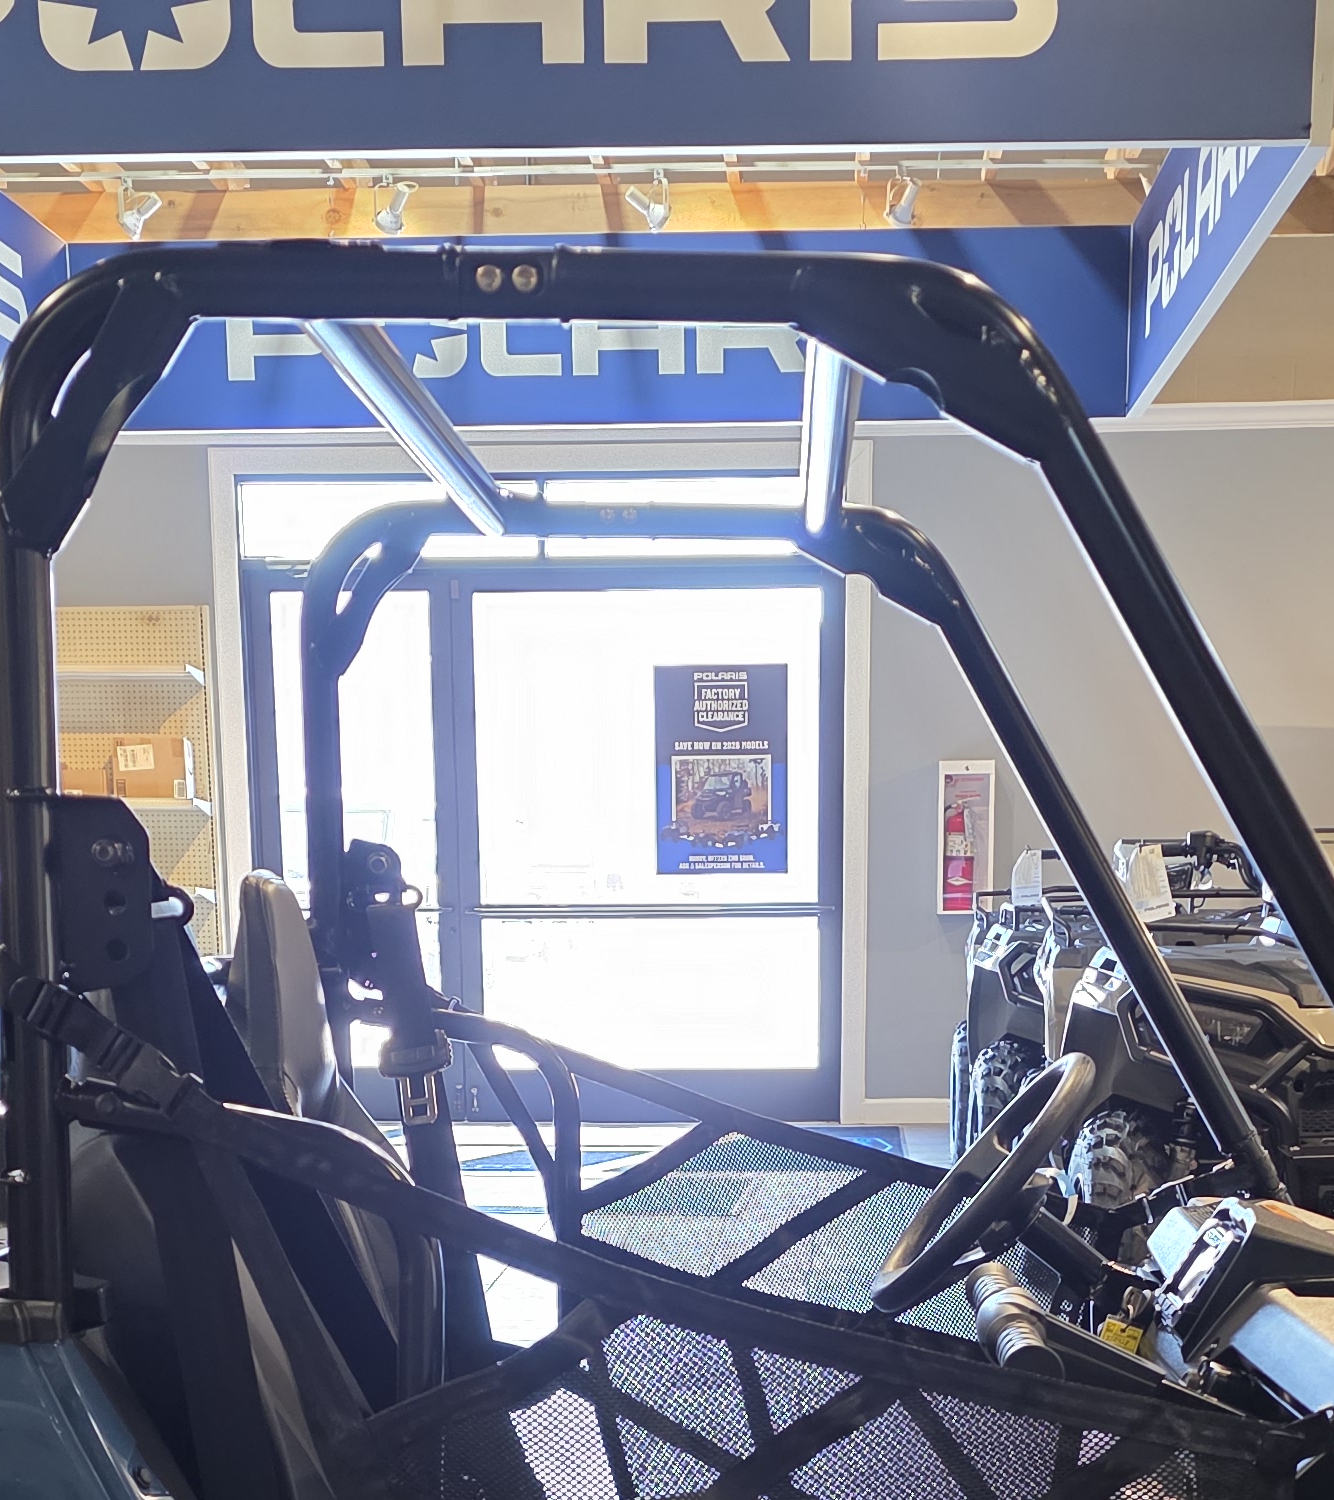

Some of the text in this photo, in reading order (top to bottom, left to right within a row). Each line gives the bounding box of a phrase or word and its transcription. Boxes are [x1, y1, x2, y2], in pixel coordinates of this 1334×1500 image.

[694, 672, 747, 680] POLARIS
[702, 689, 740, 699] FACTORY
[694, 700, 748, 711] AUTHORIZED
[699, 712, 744, 721] CLEARANCE
[675, 742, 692, 750] SAVE
[742, 741, 768, 749] MODELS
